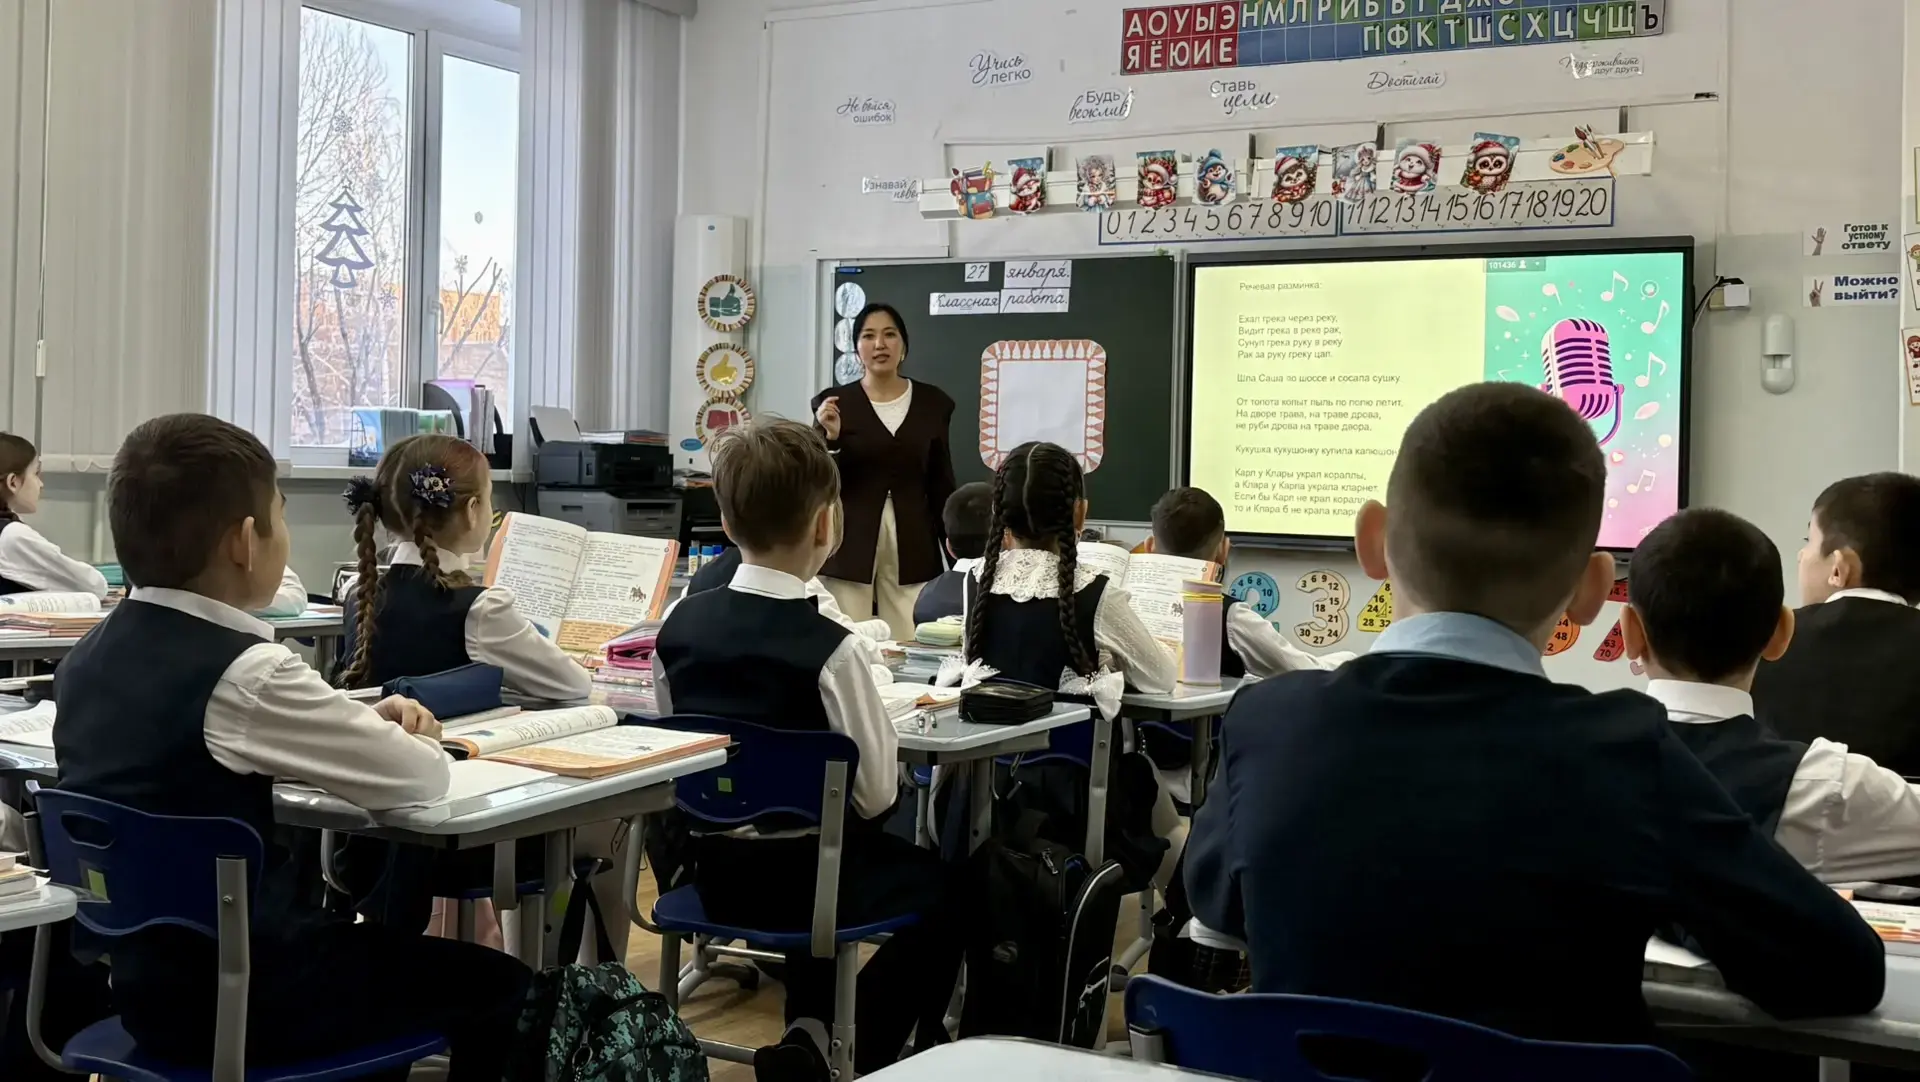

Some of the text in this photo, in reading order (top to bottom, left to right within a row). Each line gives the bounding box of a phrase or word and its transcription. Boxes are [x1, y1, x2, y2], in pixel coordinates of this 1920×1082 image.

[969, 53, 1024, 84] Учись
[990, 68, 1031, 84] легко
[1367, 71, 1441, 90] Достигай
[1210, 80, 1256, 93] Ставь
[1086, 90, 1121, 105] Будь
[836, 97, 859, 114] Не
[1223, 92, 1275, 116] цели
[853, 112, 892, 123] ошибок
[1347, 188, 1607, 224] 11 12 13 14 15 16 17 18 19 20
[1106, 212, 1121, 235] 0
[1128, 211, 1136, 234] 1
[1140, 210, 1157, 234] 2
[1163, 209, 1177, 233] 3
[1184, 208, 1198, 231] 4
[1227, 204, 1243, 230] 6
[1248, 203, 1263, 229] 7
[1268, 202, 1283, 228] 8
[1288, 202, 1305, 228] 9
[1310, 200, 1332, 227] 10
[1844, 223, 1878, 233] Готов
[1848, 231, 1885, 242] устному
[1841, 240, 1891, 250] ответу
[966, 265, 988, 280] 27
[1834, 275, 1898, 287] Можно
[1240, 282, 1275, 291] Речевая
[1834, 288, 1898, 300] выйти?
[1238, 314, 1338, 324] Ехал грека через реку,
[1238, 326, 1264, 335] Видит
[1267, 327, 1290, 336] грека
[1300, 327, 1321, 335] реке
[1324, 326, 1342, 335] рак,
[1238, 338, 1264, 348] Сунул
[1267, 339, 1290, 348] грека
[1293, 339, 1312, 348] руку
[1238, 350, 1253, 358] Рак
[1267, 351, 1286, 360] руку
[1288, 351, 1312, 360] греку
[1237, 373, 1256, 382] Шла
[1258, 373, 1284, 382] Саша
[1236, 397, 1248, 406] От
[1236, 409, 1248, 417] На
[1250, 411, 1276, 419] дворе
[1280, 411, 1307, 420] трава,
[1351, 411, 1382, 420] дрова,
[1249, 421, 1269, 431] руби
[1314, 424, 1340, 432] траве
[1236, 444, 1271, 455] Кукушка
[1274, 447, 1319, 456] кукушонку
[1321, 447, 1353, 456] купила
[1235, 467, 1256, 477] Карл
[1265, 468, 1294, 479] Клары
[1296, 471, 1322, 479] украл
[1242, 480, 1268, 490] Клара
[1279, 481, 1305, 490] Карла
[1308, 484, 1338, 492] украла
[1234, 492, 1256, 500] Если
[1258, 492, 1270, 500] бы
[1273, 493, 1294, 502] Карл
[1310, 496, 1331, 504] крал
[1253, 504, 1280, 514] Клара
[1304, 507, 1330, 516] крала
[1247, 576, 1253, 584] 6
[1256, 578, 1262, 586] 8
[1311, 575, 1317, 583] 6
[1321, 574, 1327, 582] 9
[1328, 582, 1339, 591] 12
[1230, 589, 1237, 597] 2
[1262, 588, 1273, 596] 10
[1329, 598, 1340, 606] 15
[1374, 595, 1385, 604] 16
[1256, 604, 1267, 612] 12
[1315, 604, 1326, 612] 18
[1367, 604, 1379, 613] 24
[1328, 615, 1339, 623] 21
[1362, 618, 1374, 627] 28
[1299, 629, 1311, 637] 30
[1327, 629, 1339, 638] 24
[1554, 632, 1568, 641] 48
[1313, 636, 1324, 644] 27
[1604, 640, 1616, 648] 63
[1600, 649, 1611, 658] 70
